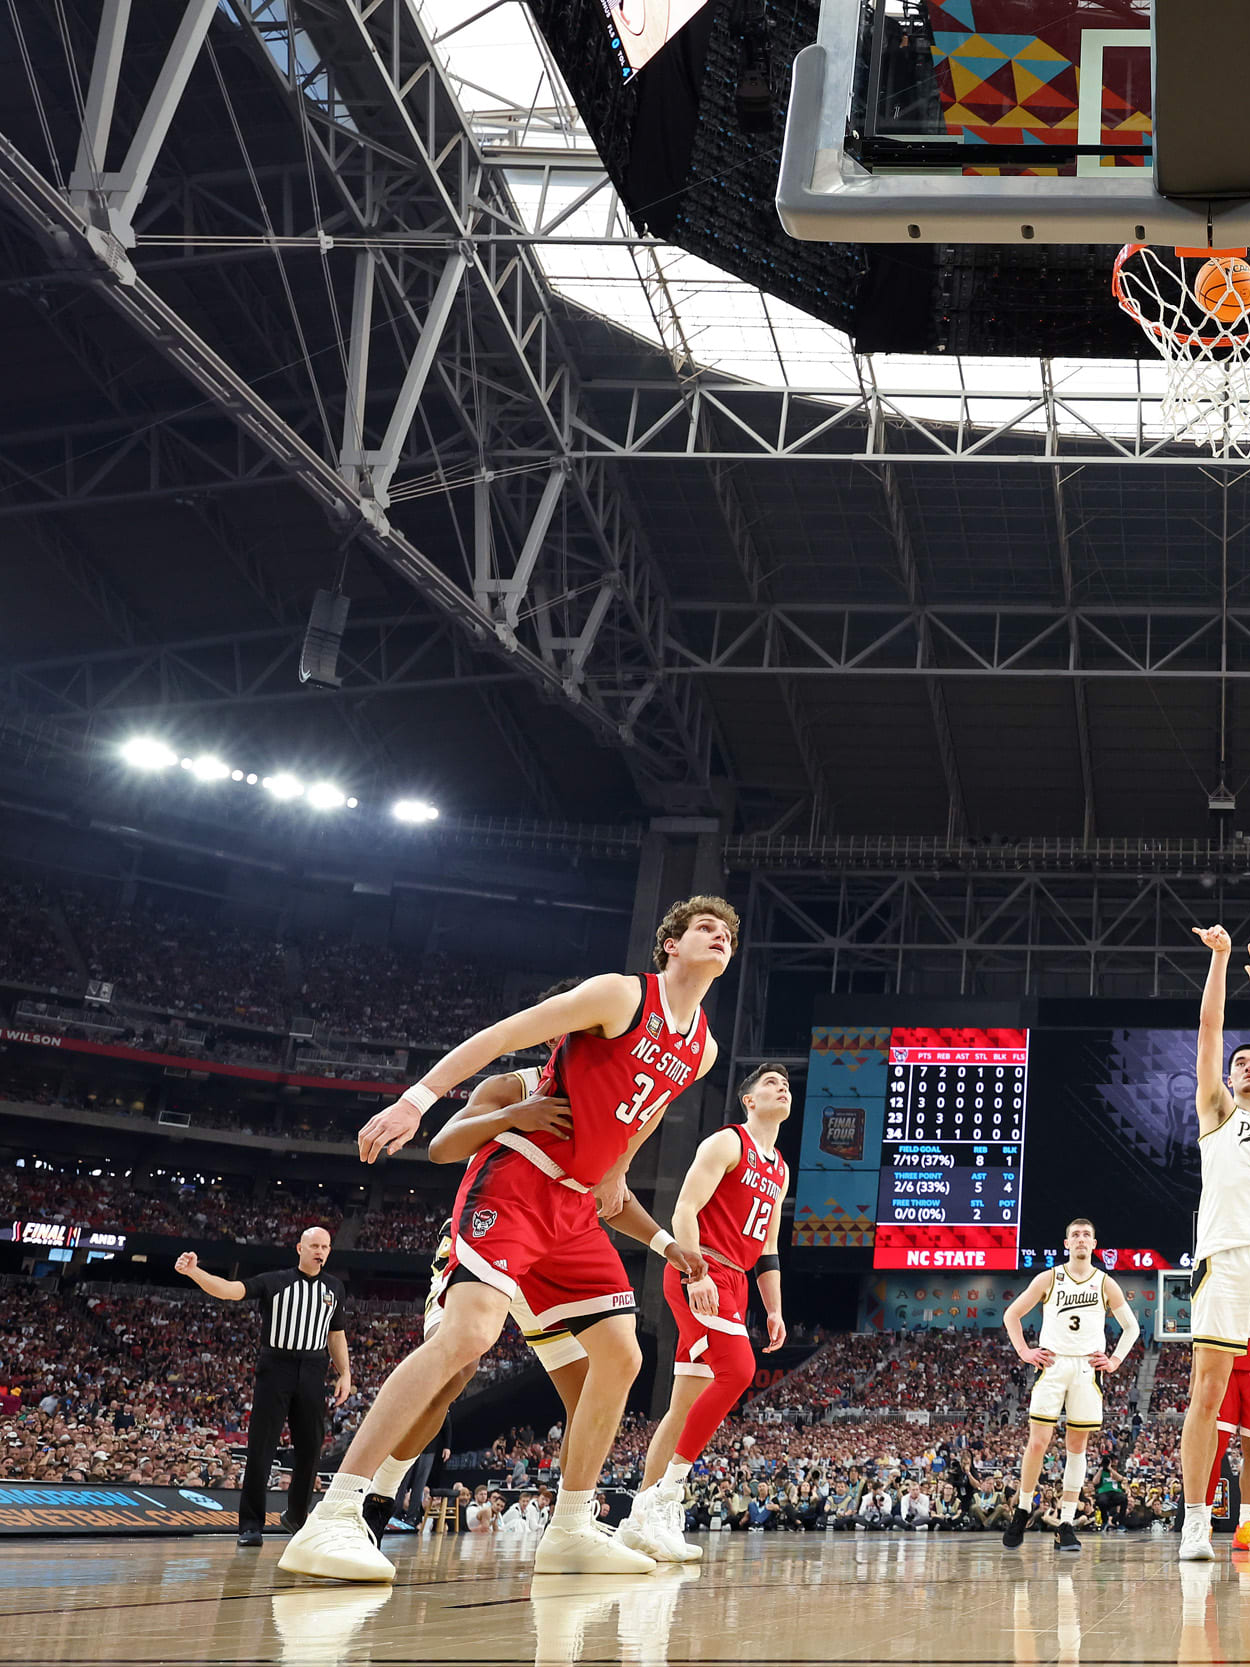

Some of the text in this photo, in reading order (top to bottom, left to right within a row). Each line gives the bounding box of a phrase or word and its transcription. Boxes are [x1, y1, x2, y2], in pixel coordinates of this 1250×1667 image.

[7, 1030, 62, 1047] WILSON
[630, 1036, 693, 1086] NC STATE
[895, 1066, 983, 1077] 0 7 2 1
[891, 1081, 927, 1092] 10 0
[615, 1072, 672, 1131] 34
[890, 1097, 925, 1108] 12 3
[828, 1117, 856, 1128] FINAL
[888, 1113, 1018, 1124] 23 0 3 1
[827, 1128, 855, 1139] FOUR
[886, 1128, 960, 1139] 34 0 1 1
[893, 1154, 1011, 1168] 7/19 (37%) 8 1
[740, 1168, 760, 1188] NC
[894, 1181, 1012, 1195] 2/6 (33%) 5 4
[742, 1196, 773, 1242] 12
[895, 1208, 1011, 1222] 0/0 (0%) 2 0
[22, 1222, 66, 1240] FINAL
[89, 1233, 116, 1246] AND
[907, 1251, 985, 1266] NC STATE
[1023, 1257, 1055, 1268] 3 3
[1132, 1253, 1153, 1267] 16
[1056, 1290, 1099, 1306] Purdue
[1069, 1315, 1081, 1331] 3
